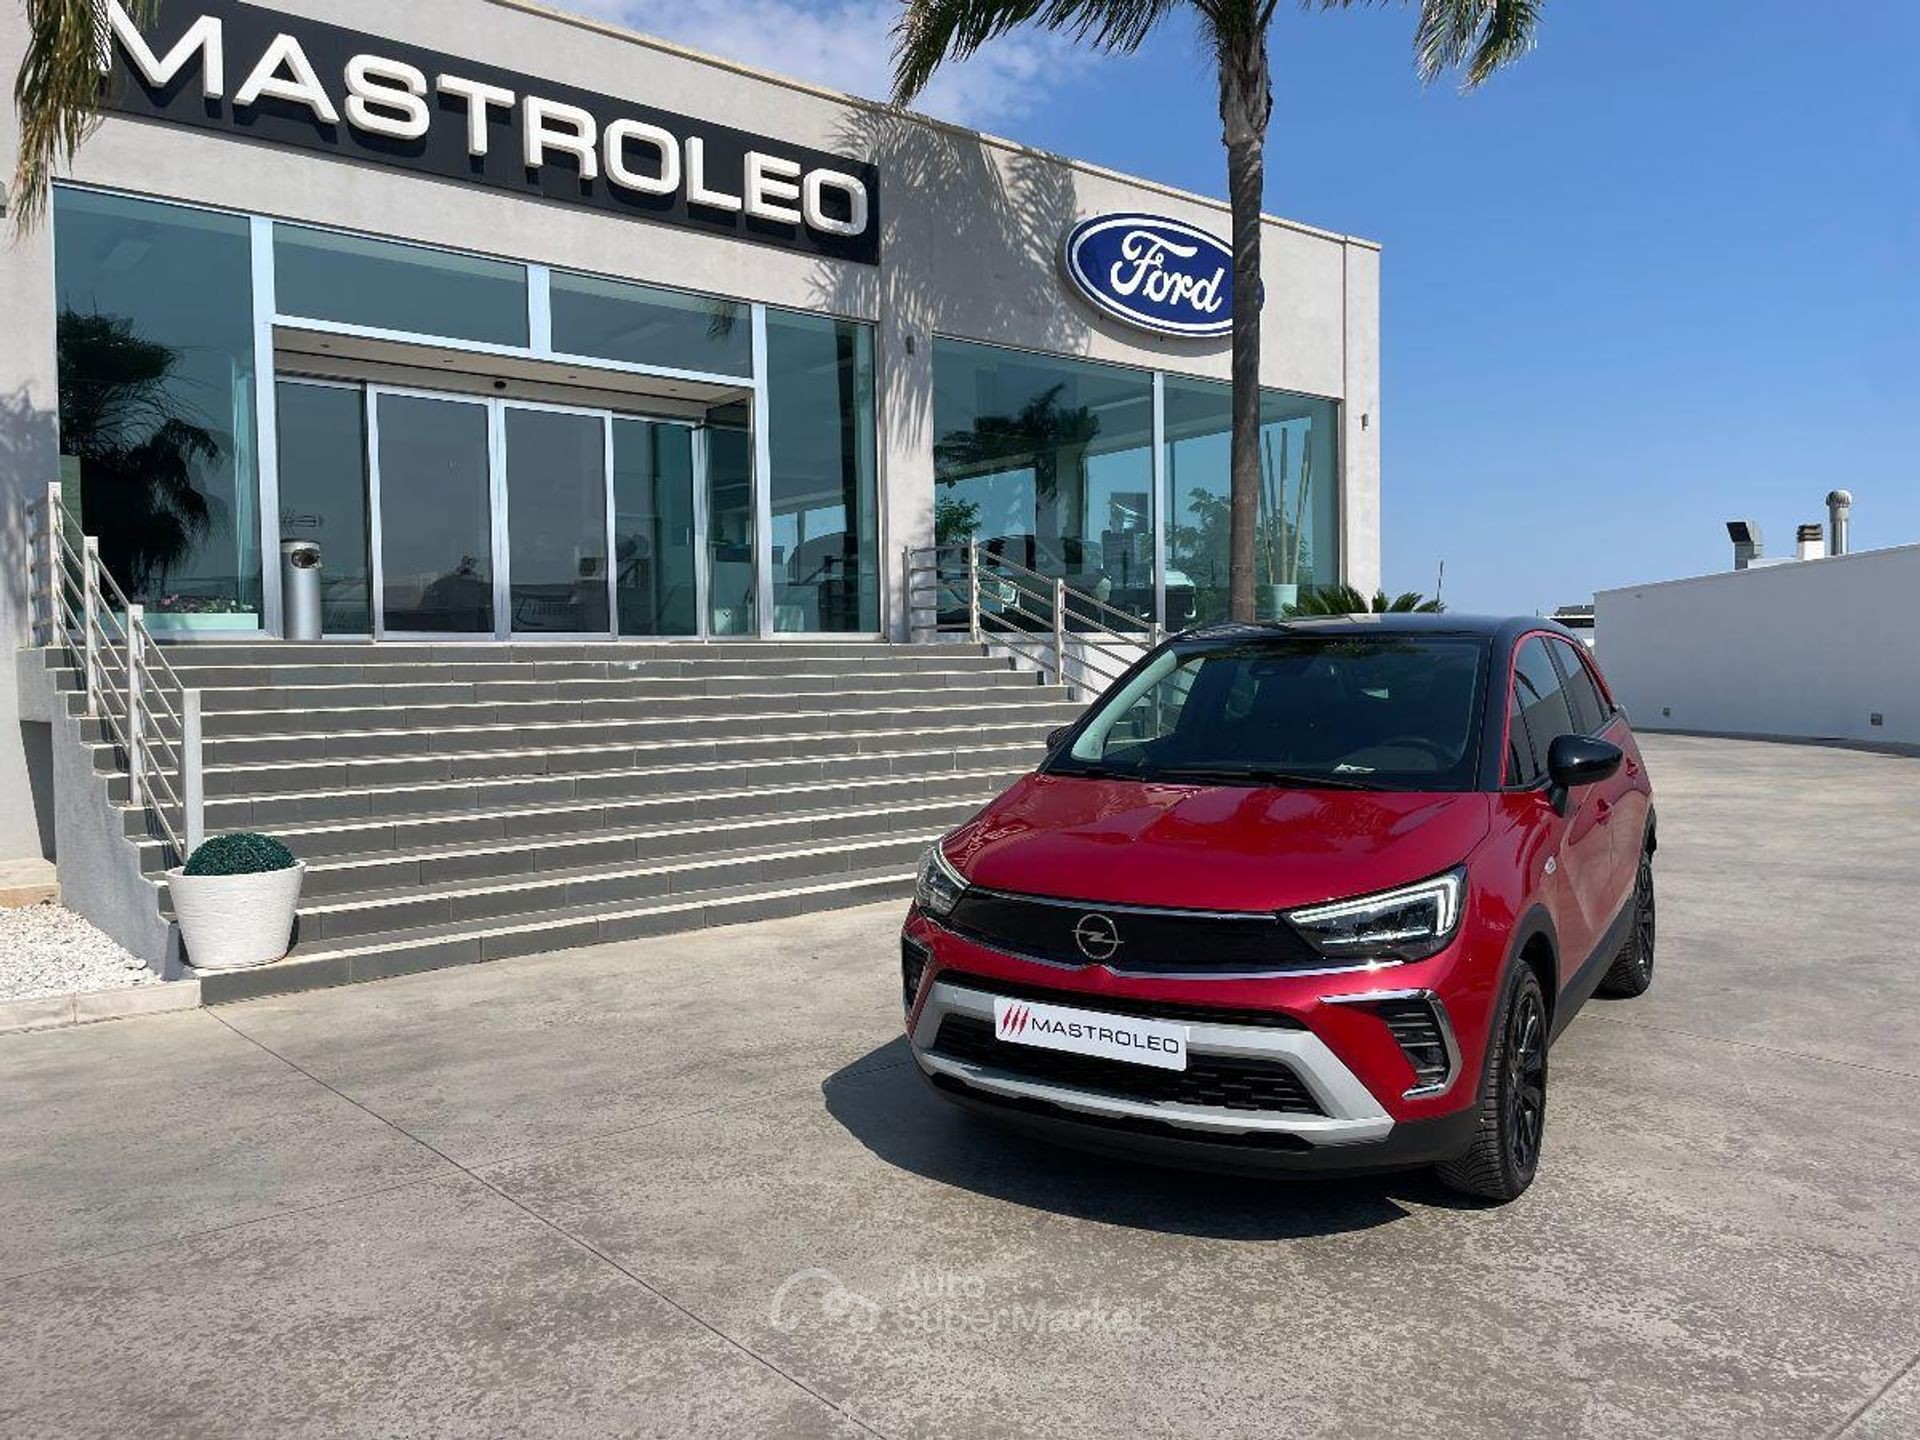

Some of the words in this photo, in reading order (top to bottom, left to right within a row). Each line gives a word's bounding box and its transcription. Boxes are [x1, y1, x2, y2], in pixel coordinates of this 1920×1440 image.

[95, 0, 868, 237] MASTROLEO
[1110, 230, 1225, 313] Ford
[1031, 1018, 1179, 1054] MASTROLEO
